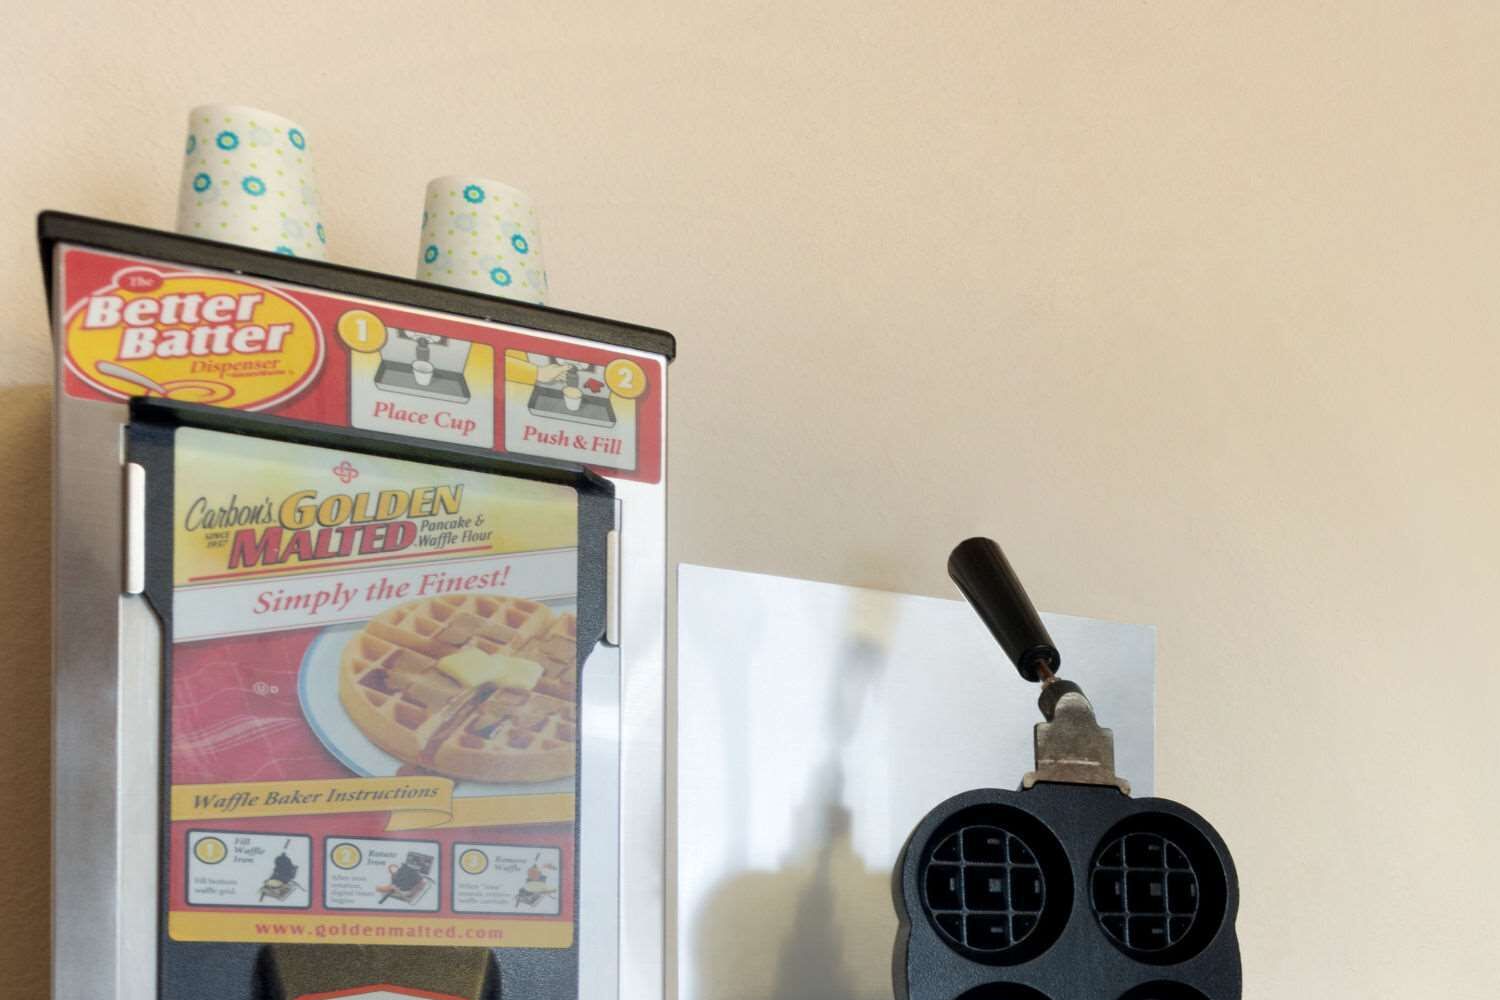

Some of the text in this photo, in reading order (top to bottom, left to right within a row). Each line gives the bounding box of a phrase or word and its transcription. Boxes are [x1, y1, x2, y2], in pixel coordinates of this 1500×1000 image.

[127, 276, 156, 288] The
[83, 292, 264, 330] Better
[119, 323, 293, 361] Batter
[356, 319, 368, 343] 1
[190, 357, 281, 379] Dispenser
[616, 367, 634, 388] 2
[372, 400, 477, 436] Place Cup
[522, 425, 623, 455] Push & Fill
[184, 484, 465, 532] Carbon's GOLDEN
[419, 514, 486, 532] Pancake &
[227, 520, 418, 570] MALTED
[417, 529, 494, 549] Waffle Flour
[252, 565, 512, 615] Simply the Finest!
[192, 784, 440, 812] Waffle Baker Instructions
[255, 923, 504, 939] www.goldenmalted.com
